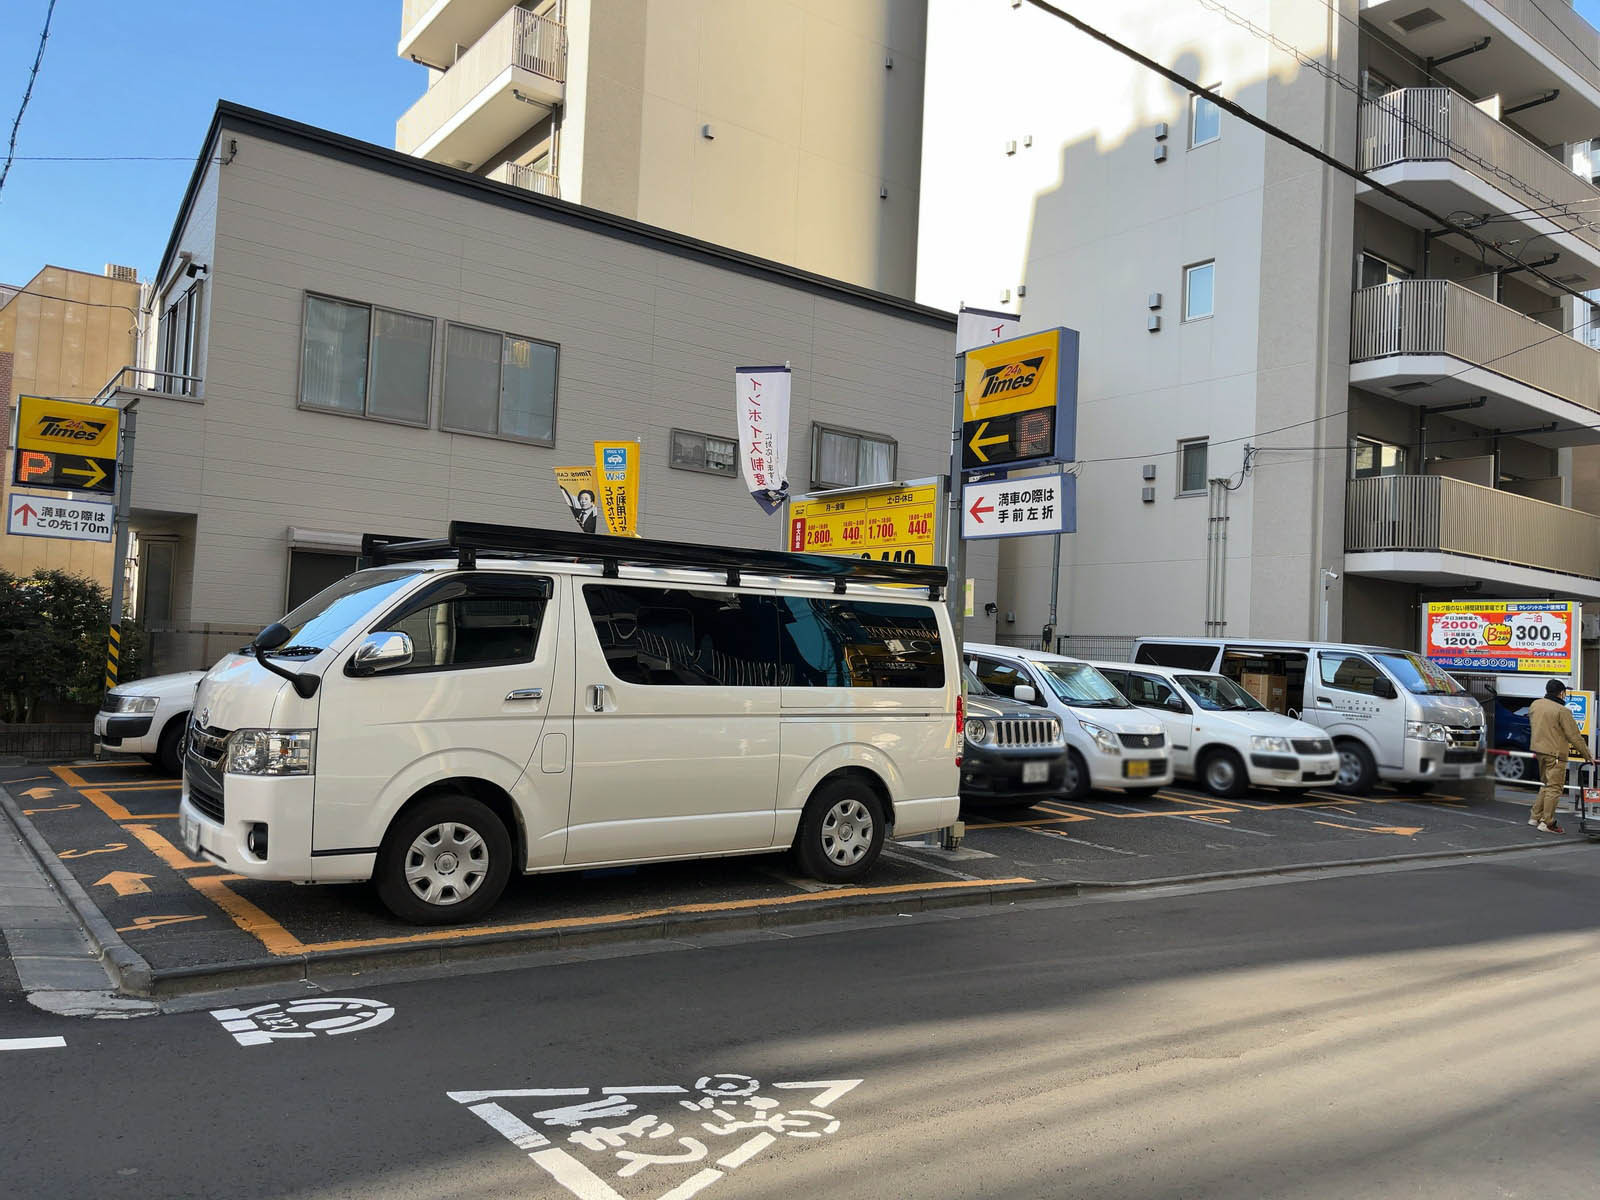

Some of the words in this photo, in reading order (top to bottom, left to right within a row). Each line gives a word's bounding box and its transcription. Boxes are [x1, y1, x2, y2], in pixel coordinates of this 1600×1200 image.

[981, 363, 1036, 398] Times
[39, 415, 98, 441] Times
[1019, 413, 1050, 457] P
[20, 451, 52, 482] P
[999, 488, 1054, 506] 満車の際は
[41, 506, 105, 522] 満車の際は
[998, 505, 1054, 523] 手前左折
[37, 518, 109, 534] この先170m
